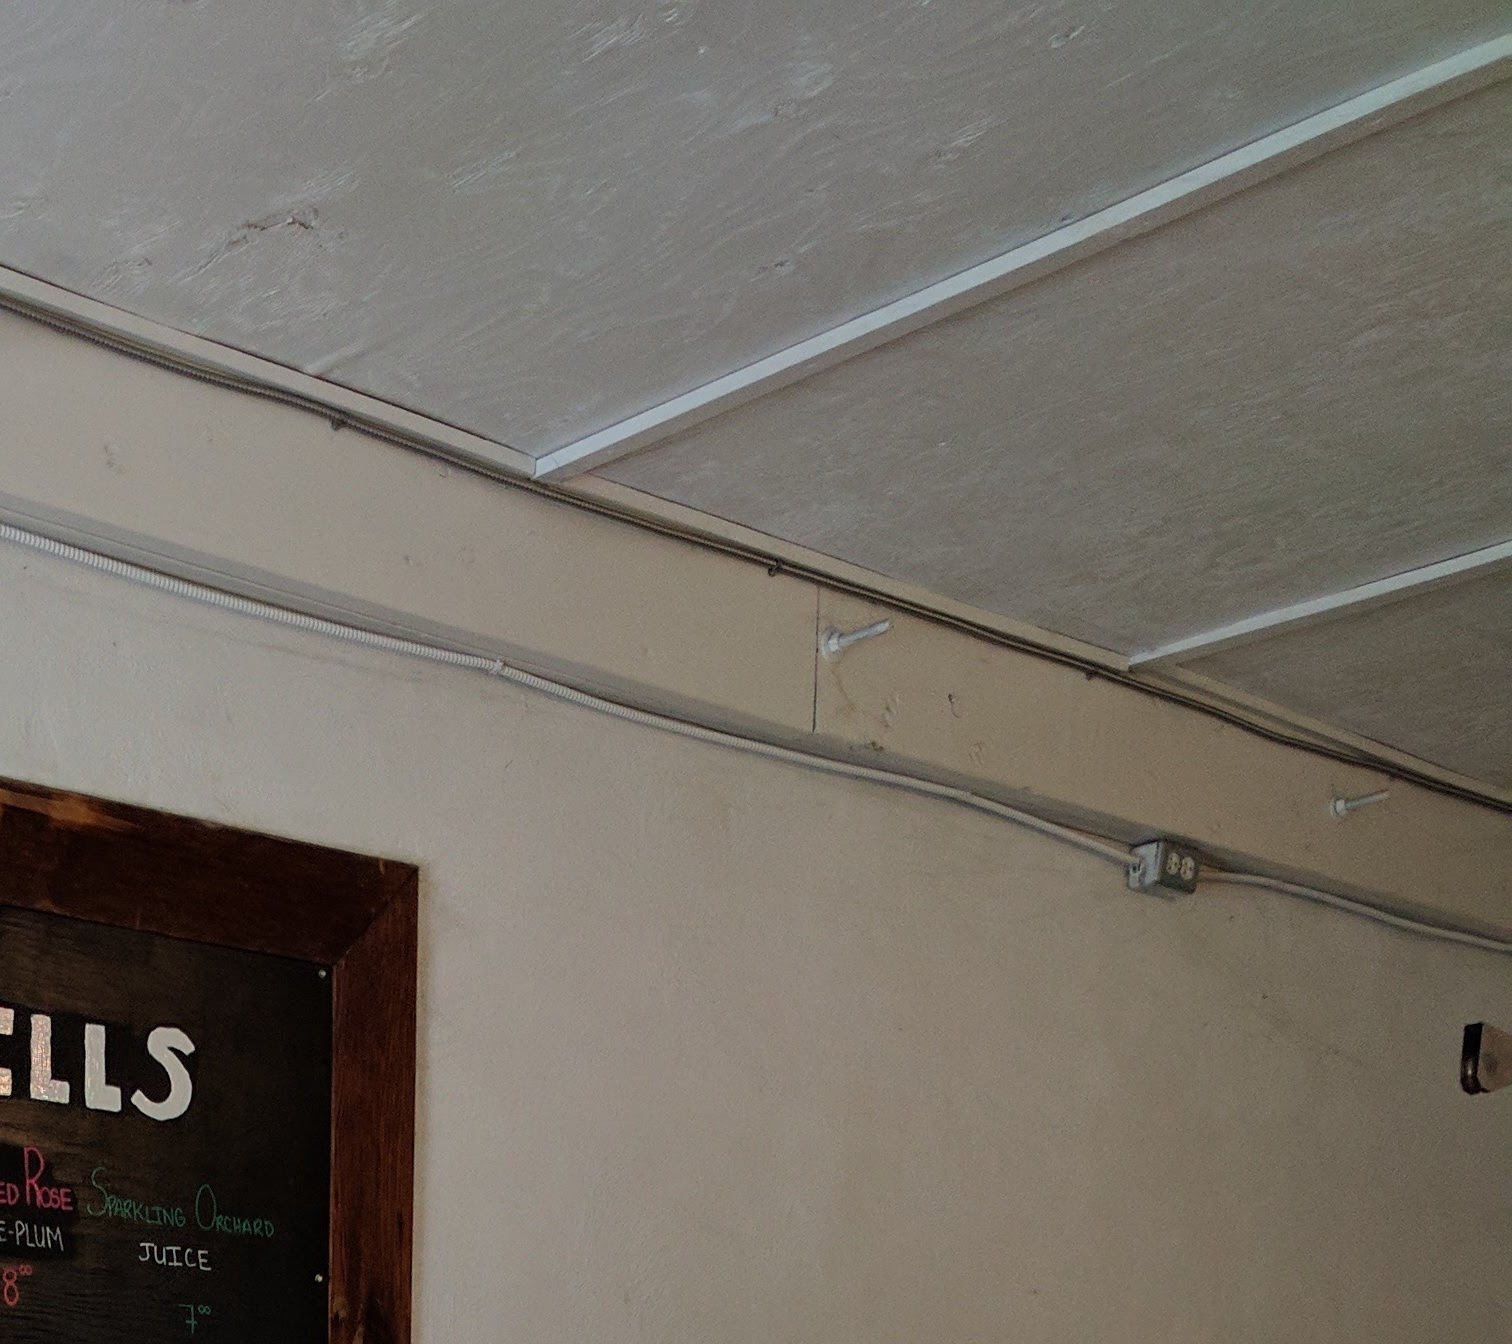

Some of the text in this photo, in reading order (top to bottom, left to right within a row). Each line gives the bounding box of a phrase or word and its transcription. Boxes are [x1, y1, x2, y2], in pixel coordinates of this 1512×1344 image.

[24, 1146, 74, 1212] ROSE
[87, 1166, 275, 1238] SPARKLING ORCHARD
[138, 1242, 212, 1272] JUICE
